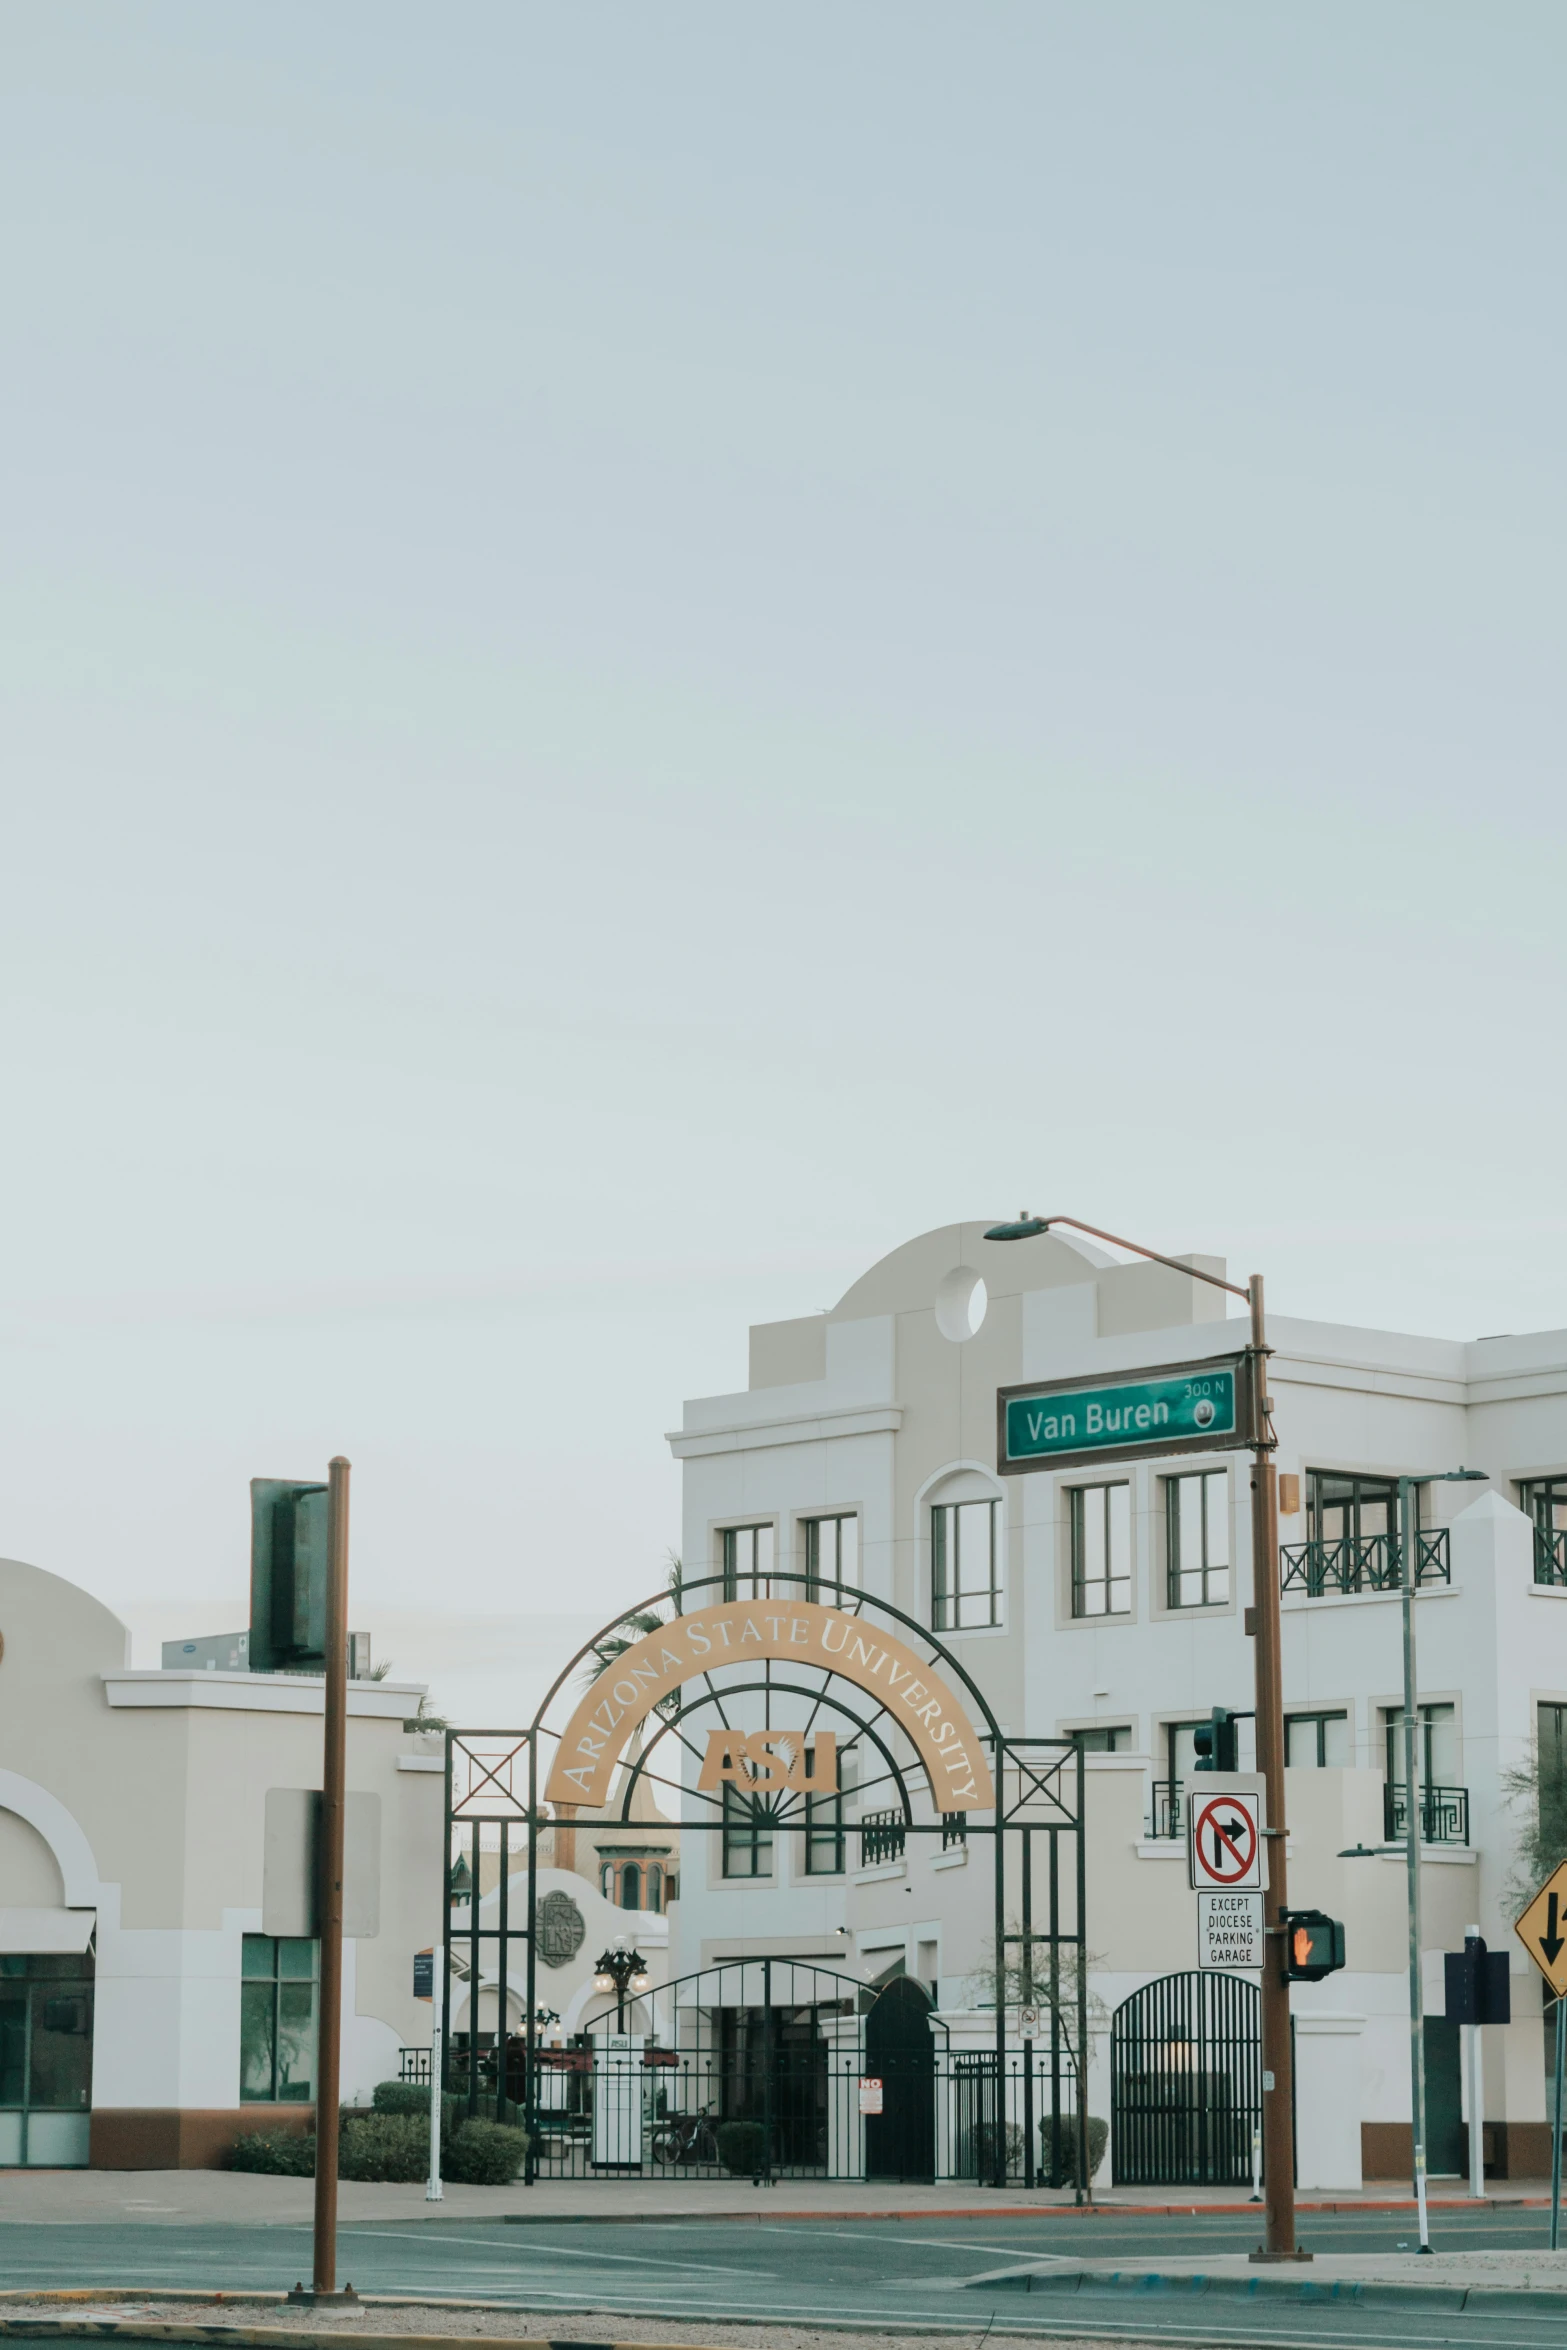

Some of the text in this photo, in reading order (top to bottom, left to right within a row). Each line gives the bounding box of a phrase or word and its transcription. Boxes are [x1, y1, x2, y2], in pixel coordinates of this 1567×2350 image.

[1184, 1380, 1224, 1399] 300 N
[1027, 1401, 1169, 1441] Van Buren
[562, 1616, 978, 1800] ARIZONA STATE UNIVERSITY
[696, 1729, 840, 1793] ASU
[1211, 1898, 1249, 1911] EXCEPT
[1208, 1915, 1252, 1928] DIOCESE
[1208, 1932, 1253, 1945] PARKING
[1210, 1949, 1252, 1962] GARAGE
[861, 2079, 881, 2088] NO
